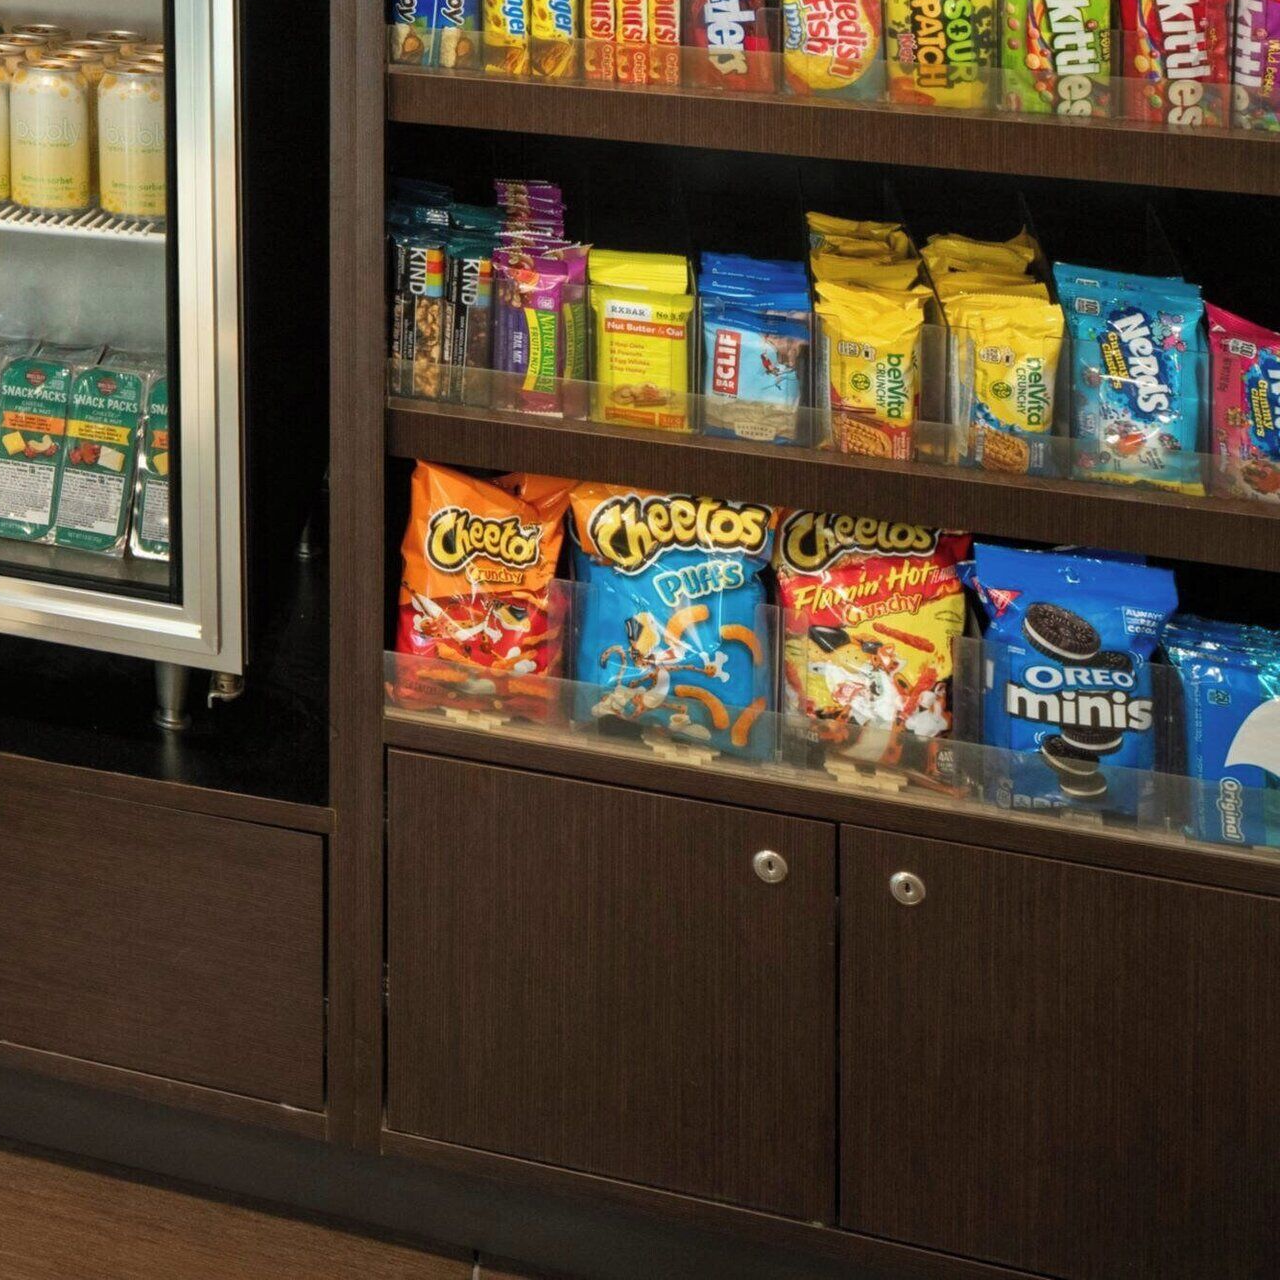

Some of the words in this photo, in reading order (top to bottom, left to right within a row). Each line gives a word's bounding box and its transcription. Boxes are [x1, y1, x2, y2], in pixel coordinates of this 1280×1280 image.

[409, 247, 427, 295] KIND
[462, 259, 480, 305] KIND
[540, 312, 556, 352] NATURE
[607, 321, 625, 330] Nut
[627, 323, 655, 334] Butter
[666, 327, 684, 338] Oat
[611, 305, 646, 317] RXBAR
[513, 331, 523, 349] TRAIL
[513, 349, 523, 364] MIX
[717, 334, 737, 379] CLIF
[1, 385, 34, 398] SNACK
[36, 388, 67, 403] PACKS
[540, 353, 556, 393] VALLEY
[716, 380, 734, 388] BAR
[876, 362, 886, 410] CRUNCHY
[886, 353, 905, 420] belVita
[1016, 367, 1026, 414] CRUNCHY
[1027, 357, 1043, 426] belVita
[73, 394, 105, 408] SNACK
[107, 399, 138, 413] PACKS
[431, 513, 541, 568] Cheetos
[594, 498, 768, 573] Cheetos
[784, 512, 937, 572] Cheetos
[656, 562, 743, 606] PUFFS
[794, 572, 882, 612] Flamin'
[888, 560, 933, 592] Hot
[843, 592, 921, 626] Crunchy
[1024, 666, 1134, 688] OREO
[1007, 681, 1153, 730] minis
[1221, 778, 1241, 841] Original
